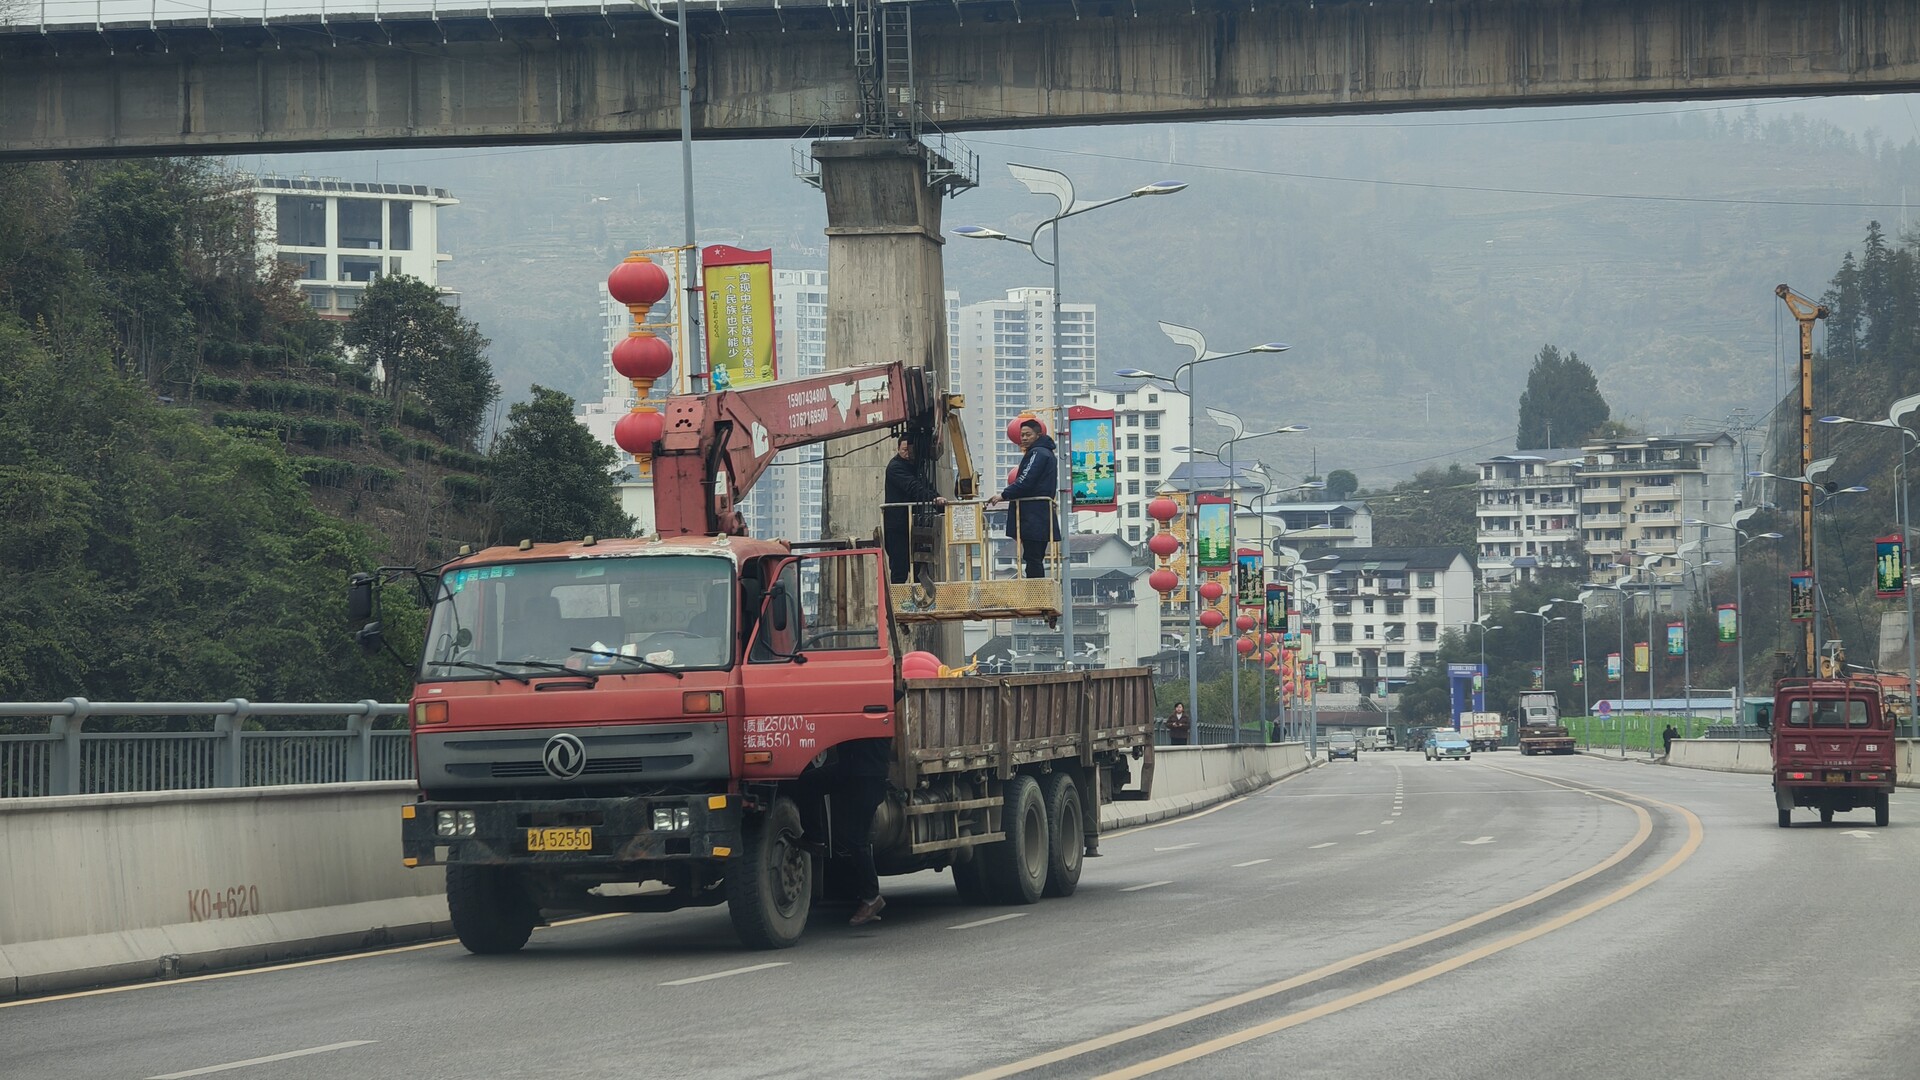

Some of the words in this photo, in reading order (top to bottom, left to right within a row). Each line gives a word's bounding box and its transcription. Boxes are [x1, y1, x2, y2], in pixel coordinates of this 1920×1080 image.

[724, 275, 739, 358] 一个民族也不能少
[739, 272, 755, 378] 实现中华民族伟大复兴
[787, 387, 827, 408] 15907434800
[788, 407, 828, 428] 13762169500
[744, 715, 803, 732] 质量25000
[799, 738, 815, 748] mm
